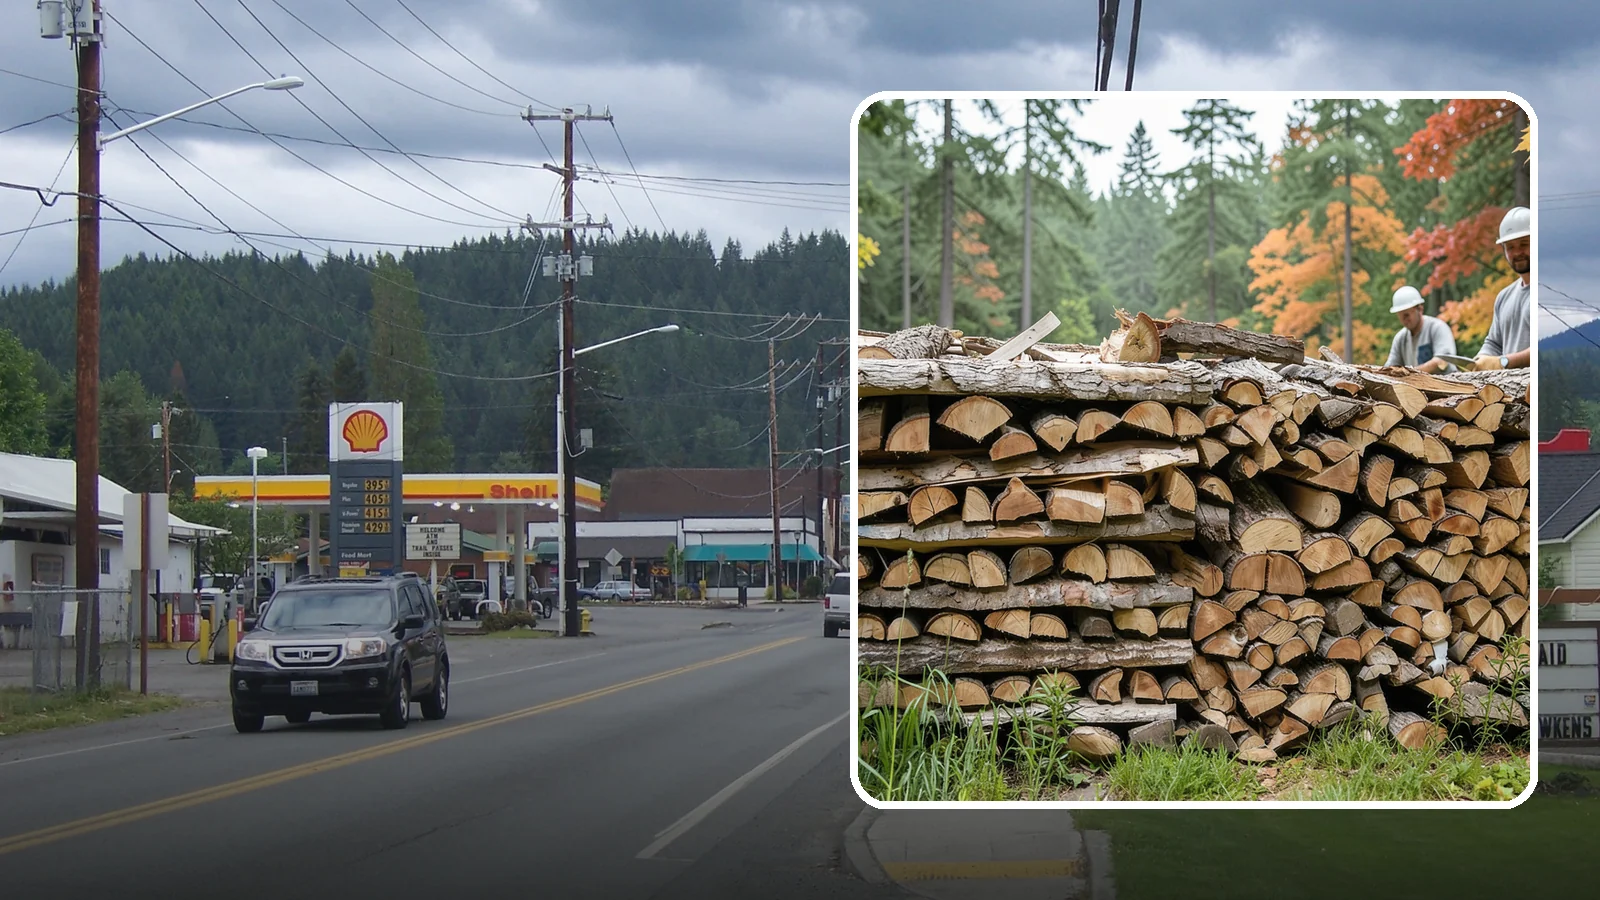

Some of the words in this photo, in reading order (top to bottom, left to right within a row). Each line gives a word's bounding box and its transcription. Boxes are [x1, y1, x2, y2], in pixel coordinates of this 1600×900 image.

[366, 480, 383, 490] 395
[489, 484, 548, 499] Shell
[366, 494, 383, 504] 405
[366, 508, 383, 518] 415
[366, 522, 383, 533] 429
